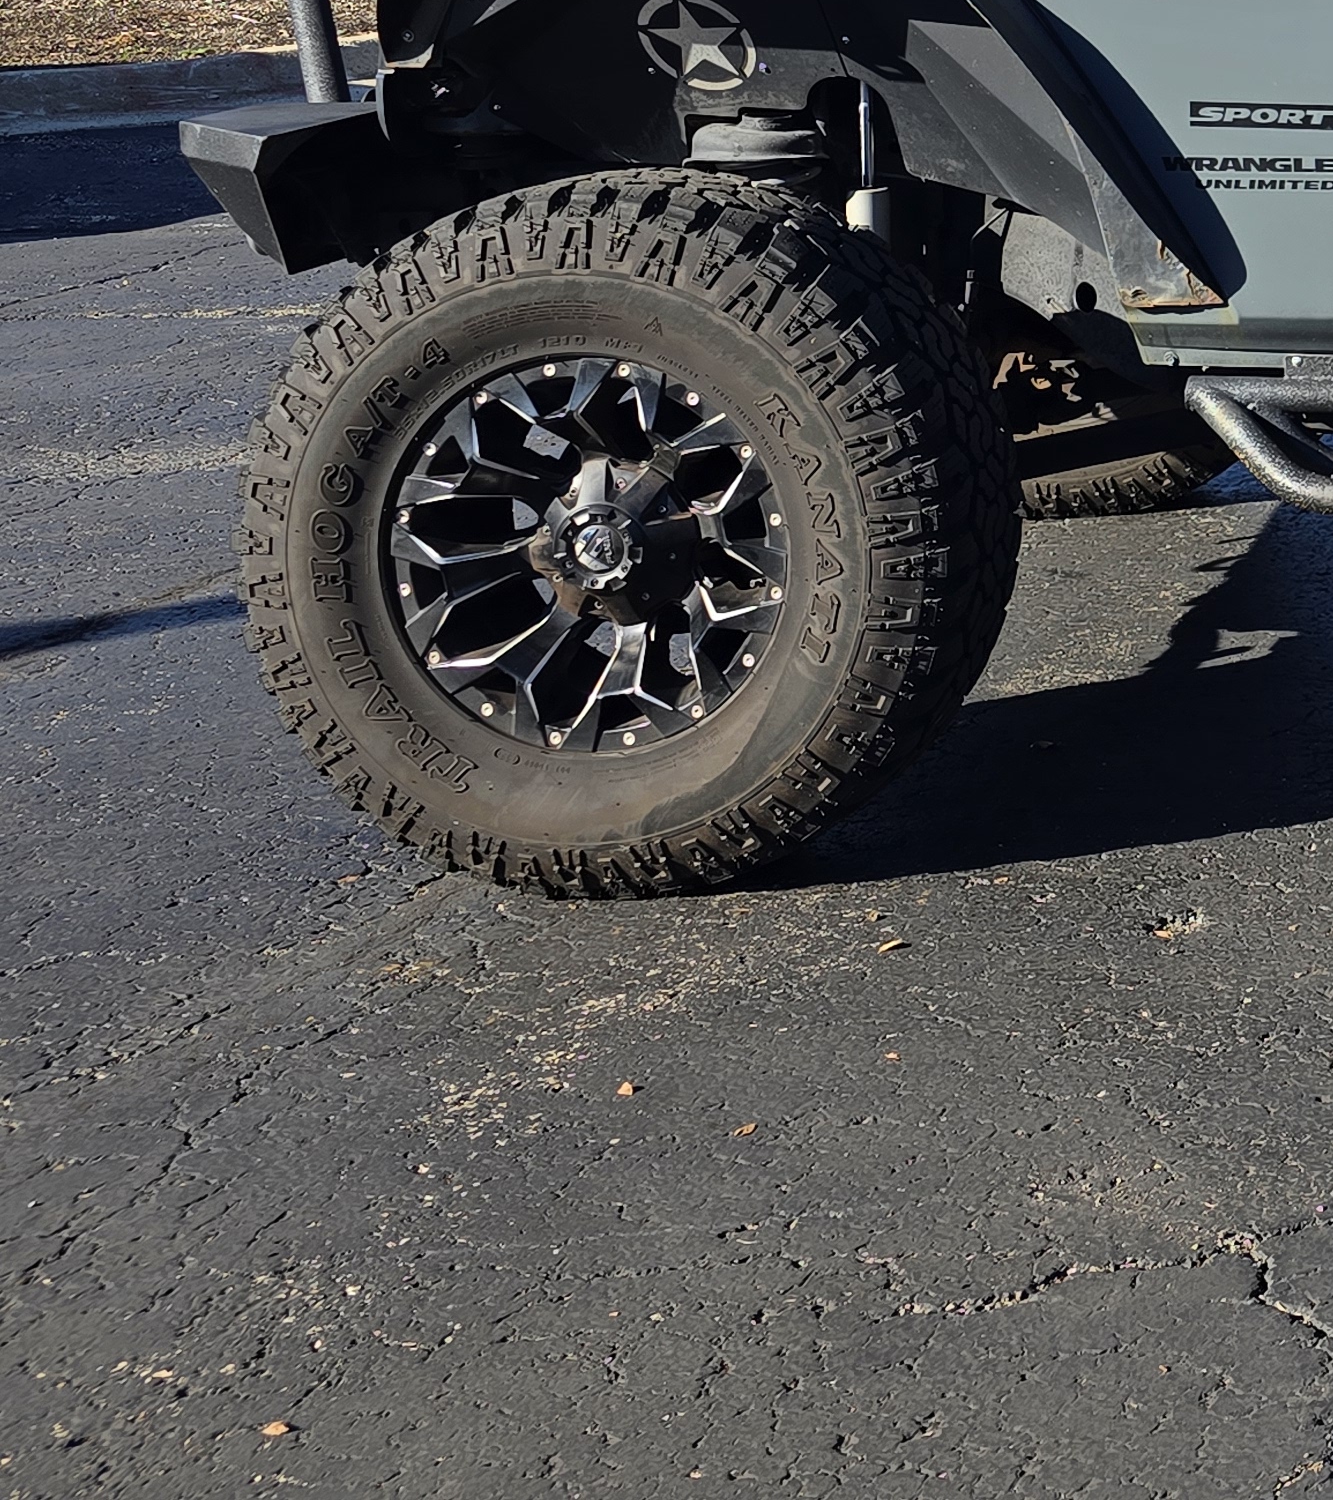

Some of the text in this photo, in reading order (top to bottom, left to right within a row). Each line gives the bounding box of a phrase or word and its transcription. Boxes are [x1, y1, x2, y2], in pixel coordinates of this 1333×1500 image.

[310, 462, 354, 602] HOG
[754, 392, 845, 664] KANATI
[327, 618, 480, 794] TRAIL
